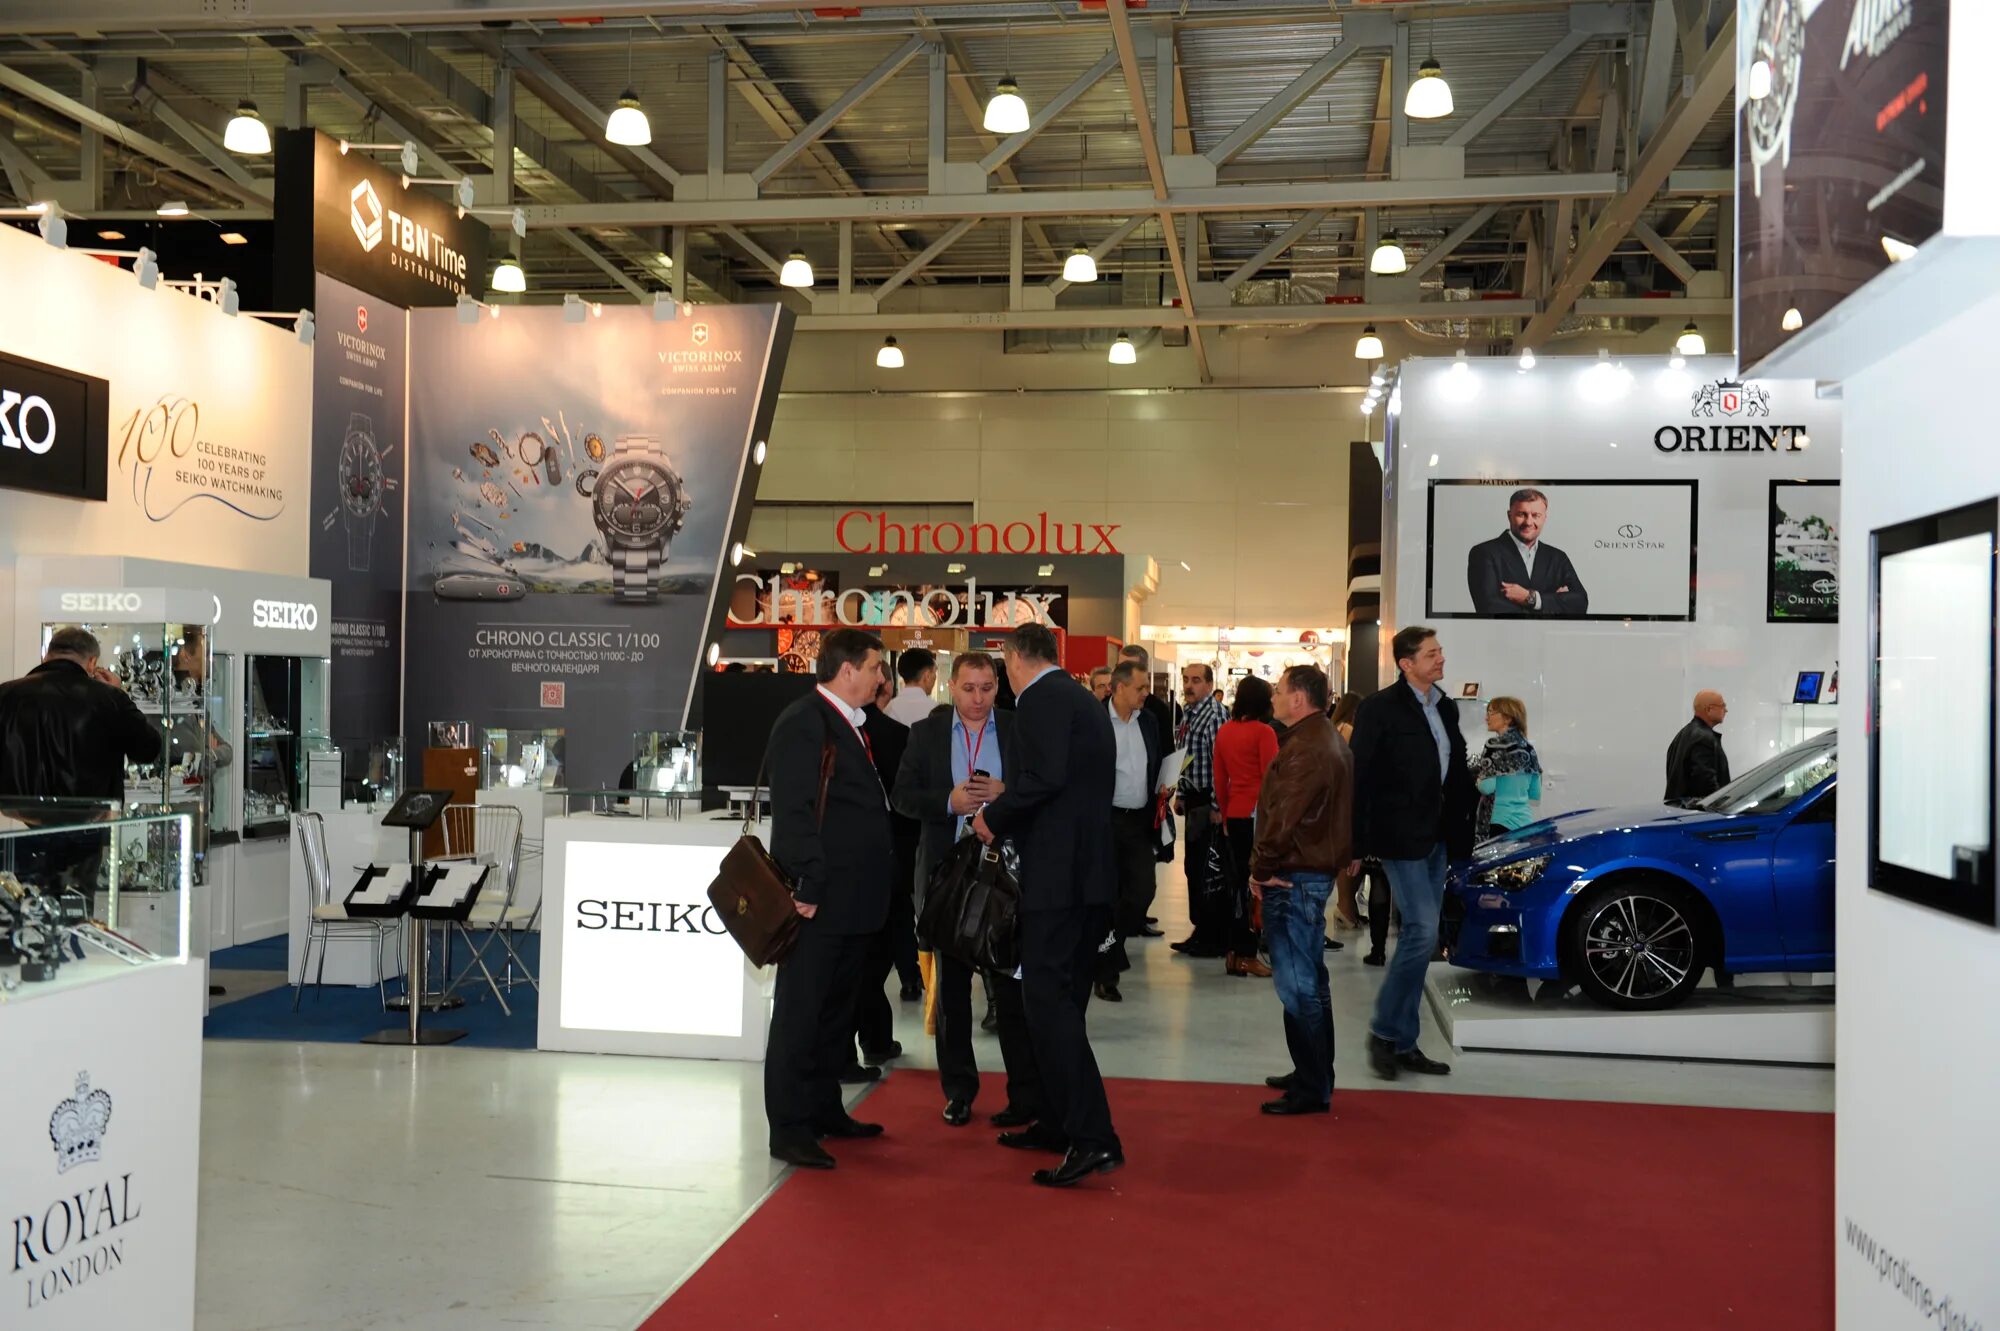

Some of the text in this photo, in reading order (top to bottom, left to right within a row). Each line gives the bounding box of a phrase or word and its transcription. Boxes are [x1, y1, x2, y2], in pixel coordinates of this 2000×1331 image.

[388, 209, 467, 280] TBN Time
[391, 252, 466, 296] DISTRIBUTION
[337, 331, 386, 361] VICTORINOX
[658, 350, 742, 363] VICTORINOX
[701, 363, 726, 373] ARMY
[706, 386, 720, 395] FOR
[721, 385, 737, 394] LIFE
[196, 441, 266, 466] CELEBRATING
[1654, 425, 1806, 453] ORIENT
[198, 459, 265, 481] 100 YEARS OF
[175, 471, 282, 501] SEIKO WATCHMAKING
[836, 510, 1121, 555] Chronolux
[61, 592, 142, 612] SEIKO
[253, 599, 318, 631] SEIKO
[728, 574, 1061, 628] Chronolux
[476, 630, 660, 648] CHRONO CLASSIC 1/100
[469, 649, 480, 658] ОТ
[482, 650, 536, 660] ХРОНОГРАФА
[546, 651, 597, 661] ТОЧНОСТЬЮ
[631, 653, 644, 662] ДО
[511, 662, 600, 675] ВЕЧНОГО КАЛЕНДАРЯ
[577, 900, 728, 934] SEIKO
[10, 1172, 142, 1273] ROYAL
[25, 1238, 125, 1310] LONDON
